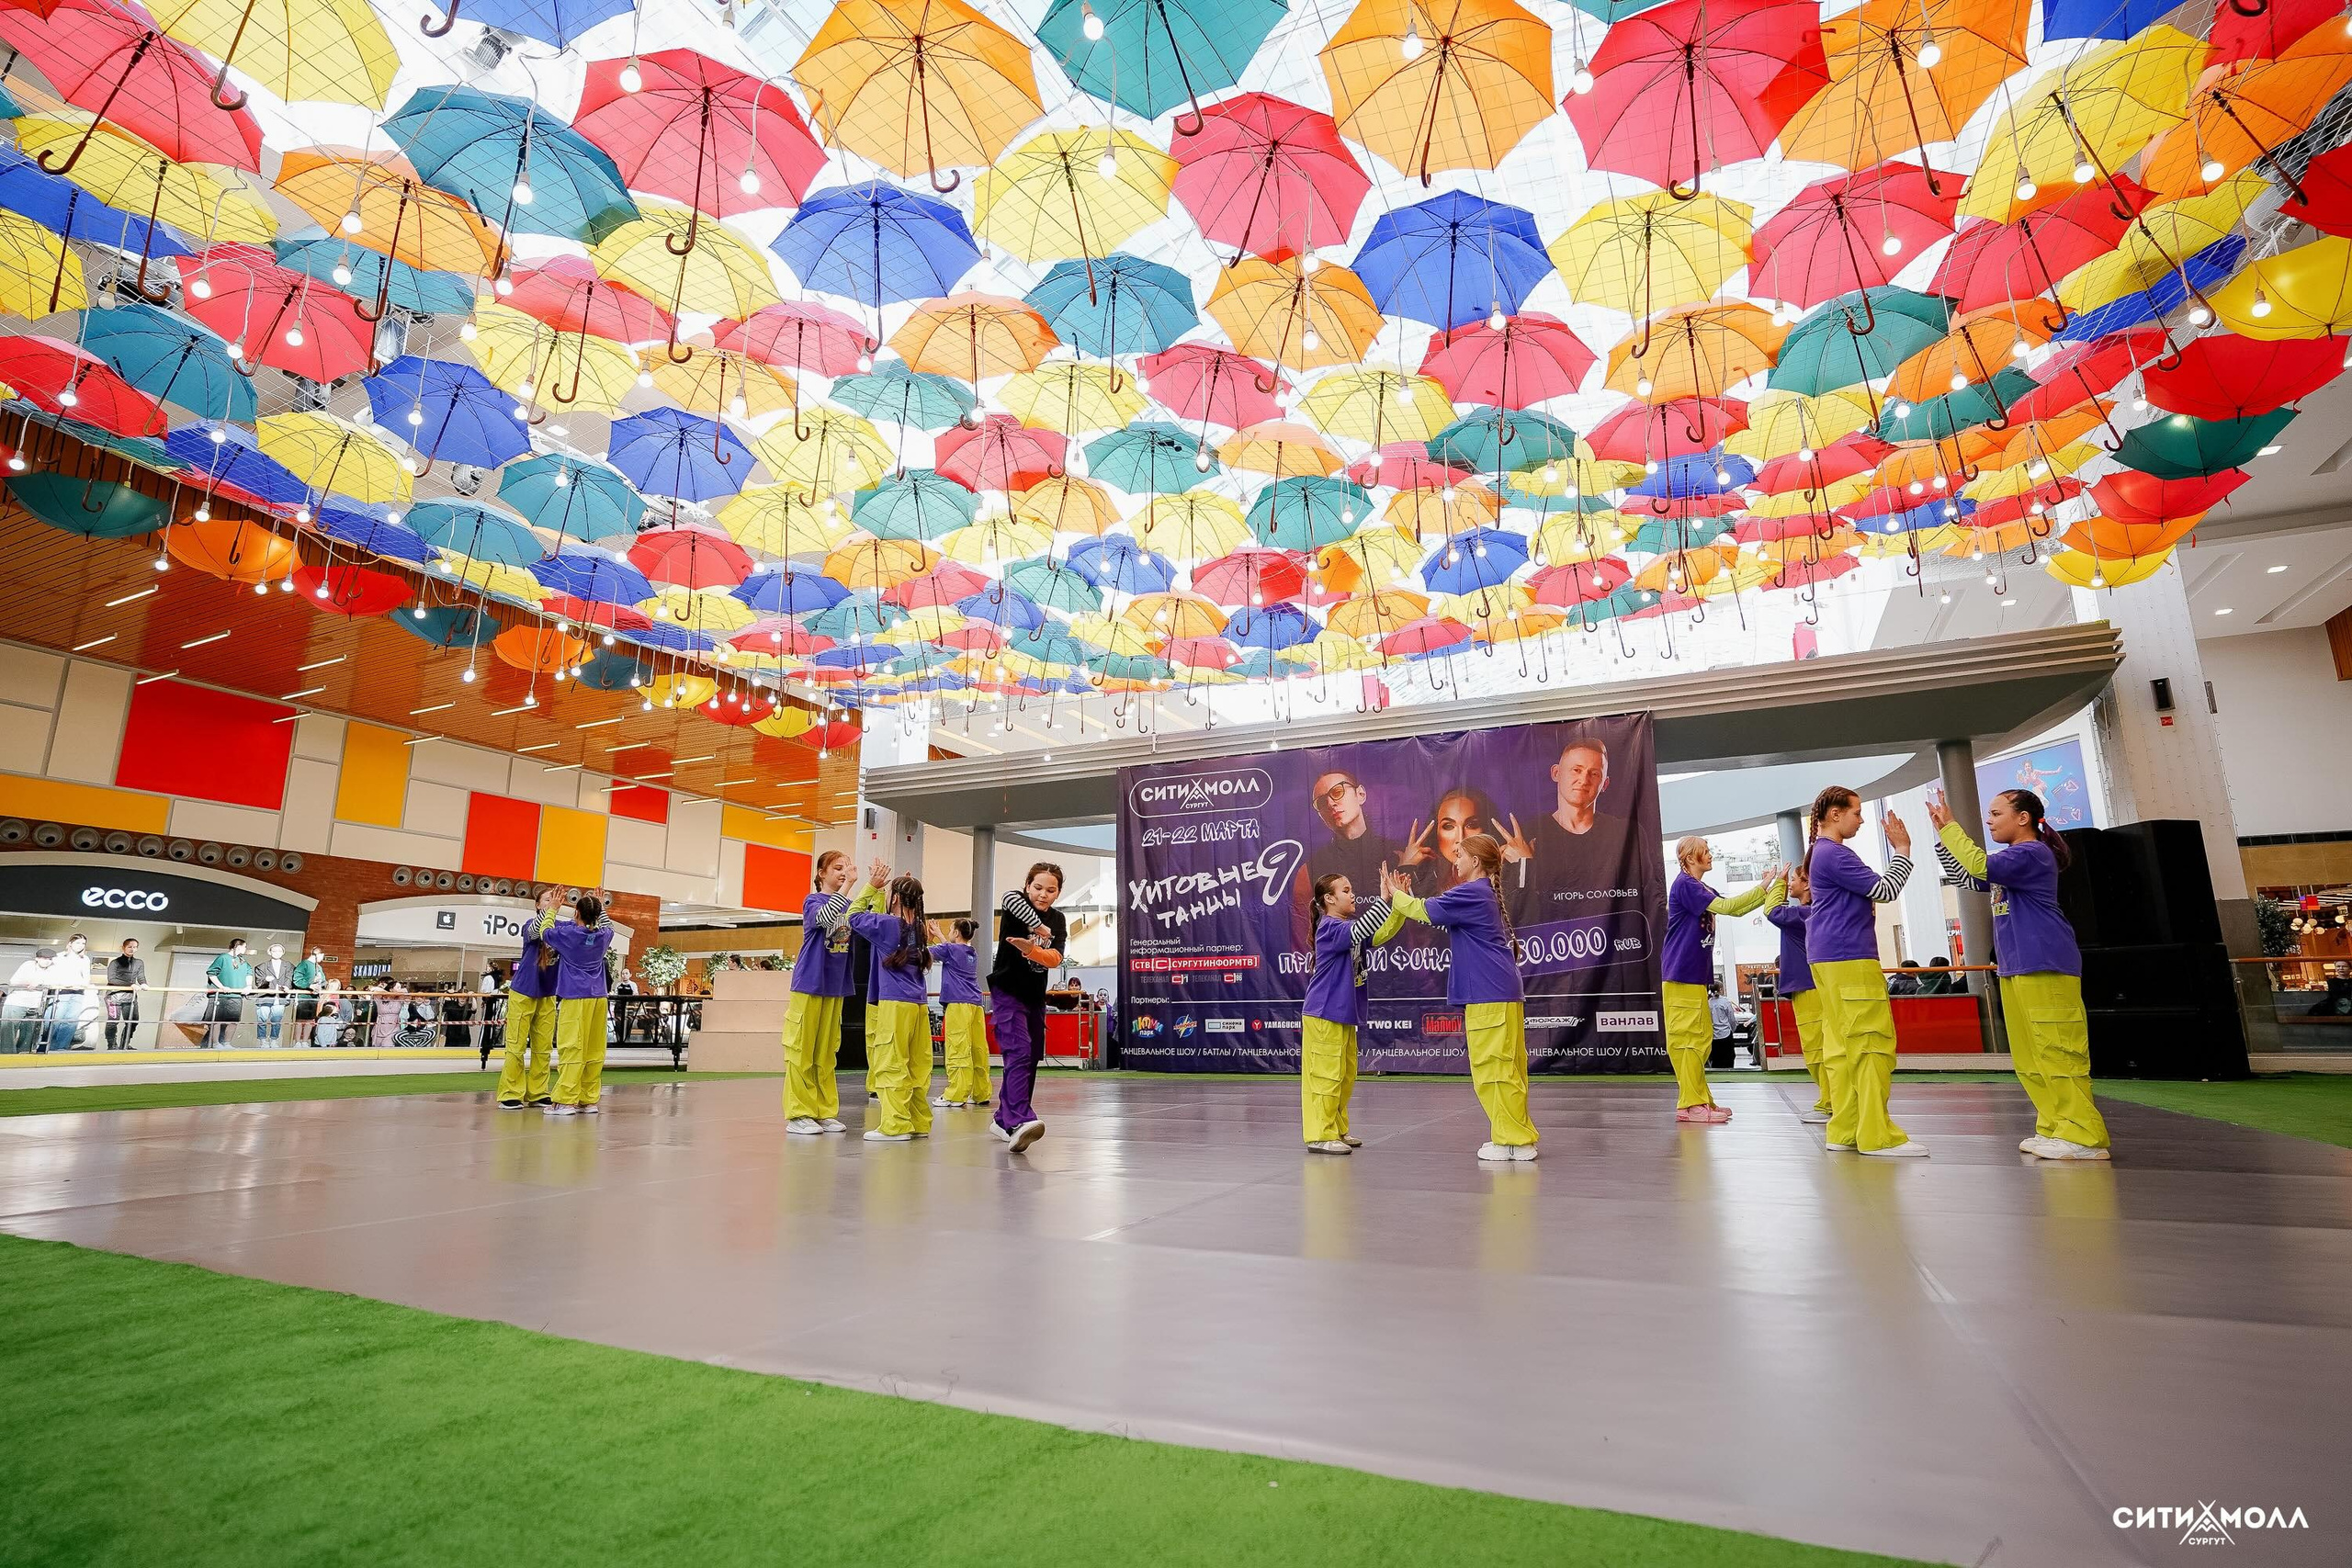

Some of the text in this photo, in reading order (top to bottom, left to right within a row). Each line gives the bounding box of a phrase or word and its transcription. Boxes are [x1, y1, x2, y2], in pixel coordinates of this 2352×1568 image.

[1140, 777, 1261, 802] СИТИ МОЛЛ
[1185, 801, 1209, 809] СУРГУТ
[1141, 818, 1260, 847] 21-22 МАРТА
[1128, 862, 1260, 913] ХИТОВЫЕ
[82, 886, 169, 911] ecco
[1554, 888, 1639, 901] ИГОРЬ СОЛОВЬЕВ
[1157, 888, 1241, 929] ТАНЦЫ
[483, 914, 525, 937] iPo
[1129, 937, 1182, 947] Генеральный
[1613, 937, 1642, 952] RUB
[1129, 944, 1245, 955] информационный партнер:
[1390, 946, 1453, 973] ФОНД
[1130, 996, 1170, 1006] Партнеры:
[1264, 1021, 1302, 1030] YAMAGUCHI
[1367, 1020, 1412, 1030] TWO KEI
[1600, 1017, 1655, 1027] ванлав
[1120, 1047, 1176, 1056] ТАНЦЕВАЛЬНОЕ
[1177, 1047, 1196, 1056] ШОУ
[1203, 1048, 1231, 1056] БАТТЛЫ
[1238, 1048, 1302, 1057] ТАНЦЕВАЛЬНОЕ
[1372, 1048, 1442, 1057] ТАНЦЕВАЛЬНОЕ
[1442, 1048, 1466, 1057] ШОУ
[1526, 1047, 1595, 1057] НЦЕВАЛЬНОЕ
[1597, 1047, 1623, 1056] ШОУ
